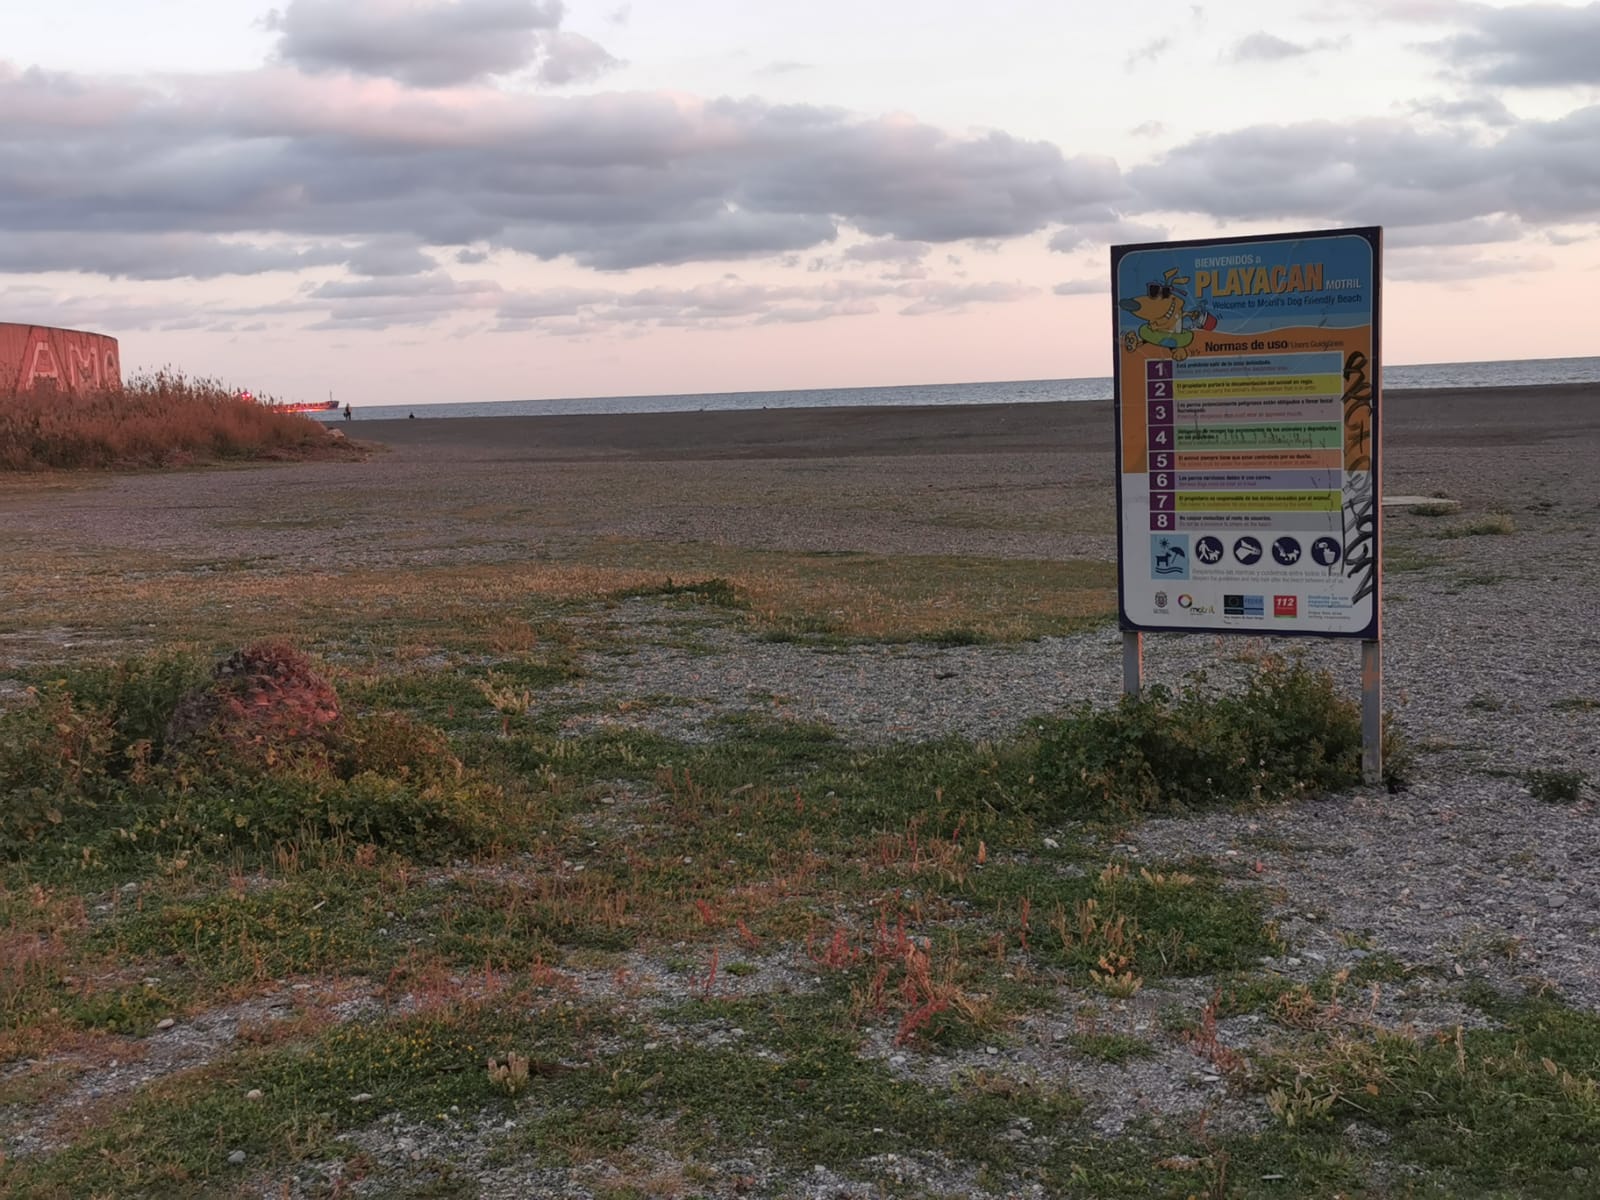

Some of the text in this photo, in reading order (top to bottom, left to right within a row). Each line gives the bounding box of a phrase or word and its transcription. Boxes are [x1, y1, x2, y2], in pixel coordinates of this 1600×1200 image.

[1194, 254, 1262, 268] BIENVENIDOS a
[1194, 263, 1361, 298] PLAYACAN MOTRIL
[1212, 299, 1246, 309] Welcome
[1248, 300, 1256, 308] to
[1288, 297, 1302, 307] Dog
[1304, 295, 1335, 305] Friendly
[1337, 294, 1362, 304] Beach
[1205, 341, 1248, 353] Normas
[1251, 340, 1264, 350] de
[1267, 340, 1288, 349] uso
[1155, 363, 1163, 376] 1
[1154, 382, 1166, 396] 2
[1155, 406, 1166, 419] 3
[1155, 431, 1167, 444] 4
[1156, 454, 1168, 467] 5
[1156, 473, 1168, 487] 6
[1156, 495, 1168, 508] 7
[1157, 514, 1168, 527] 8
[1276, 598, 1295, 607] 112
